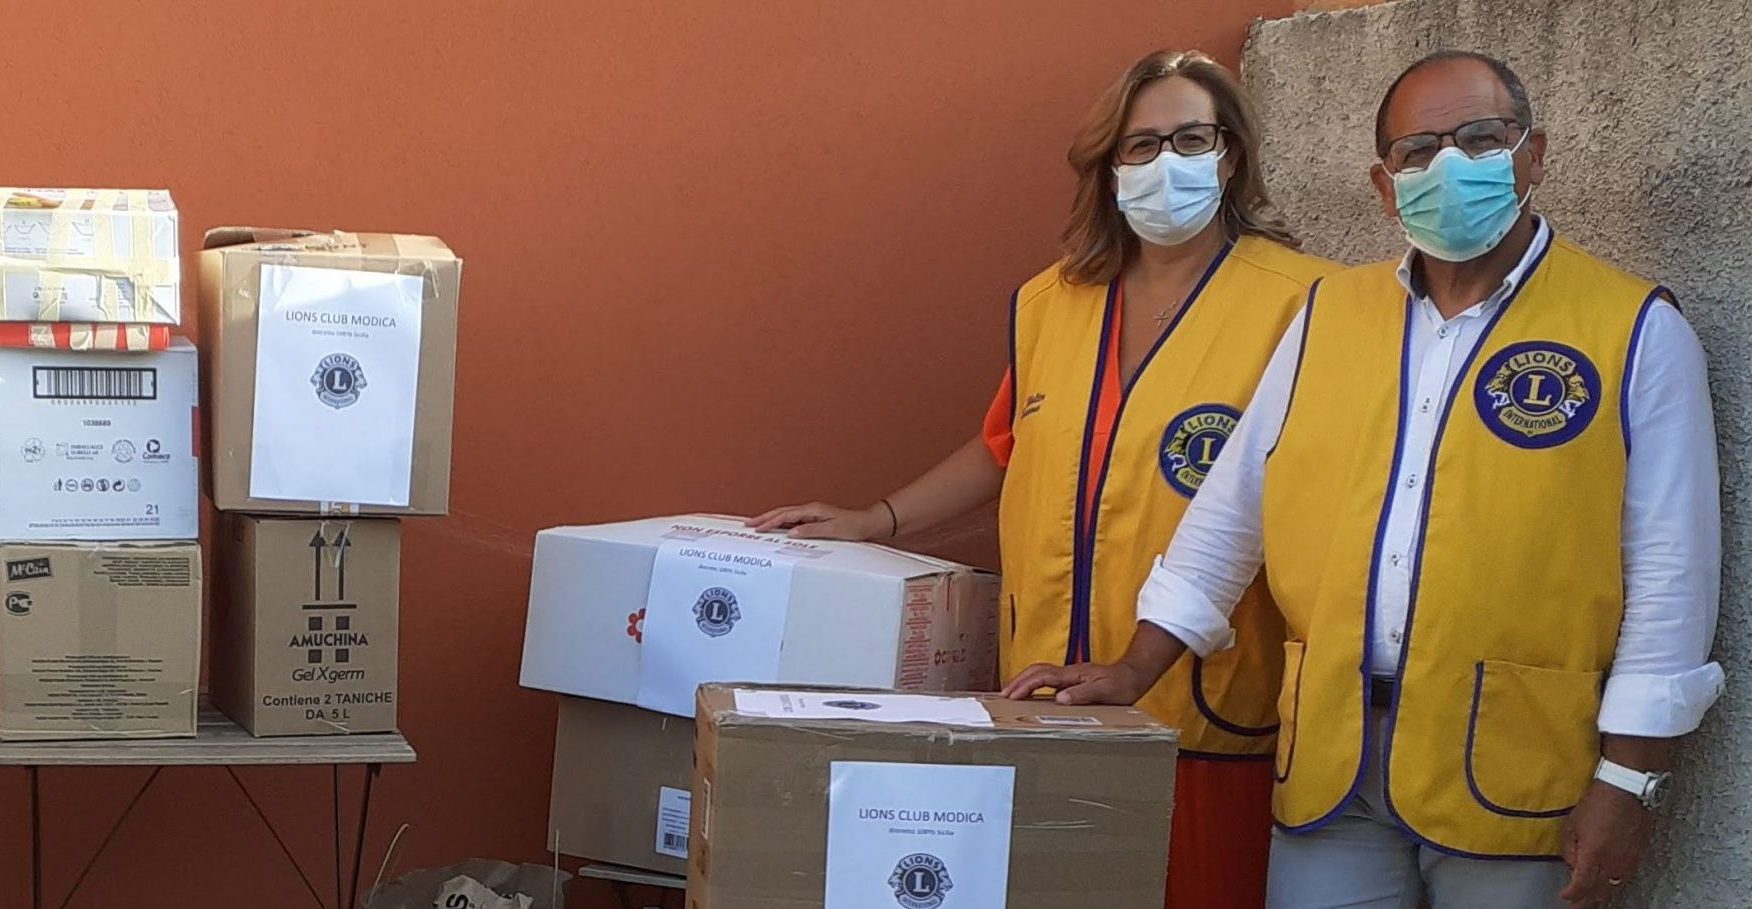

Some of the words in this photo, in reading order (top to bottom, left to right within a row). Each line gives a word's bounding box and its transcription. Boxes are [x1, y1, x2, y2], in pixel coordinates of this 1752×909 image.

[285, 311, 318, 323] LIONS
[320, 313, 348, 325] CLUB
[352, 315, 397, 328] MODICA
[324, 355, 356, 368] LIONS
[1513, 353, 1573, 372] LIONS
[332, 370, 348, 390] L
[1523, 374, 1552, 406] L
[1503, 409, 1563, 429] INTERNATIONAL
[146, 504, 160, 515] 21
[671, 524, 703, 532] NON
[783, 541, 819, 549] SOLE
[679, 548, 706, 559] LIONS
[708, 552, 731, 562] CLUB
[733, 555, 773, 568] MODICA
[705, 589, 733, 601] LIONS
[710, 602, 724, 621] L
[289, 633, 369, 647] AMUCHINA
[262, 695, 320, 706] Contiene
[324, 694, 332, 705] 2
[335, 692, 393, 704] TANICHE
[306, 709, 324, 720] DA
[332, 709, 339, 719] 5
[343, 709, 351, 719] L
[859, 808, 895, 820] LIONS
[898, 810, 930, 822] CLUB
[933, 811, 985, 823] MODICA
[903, 856, 940, 869] LIONS
[912, 872, 930, 892] L
